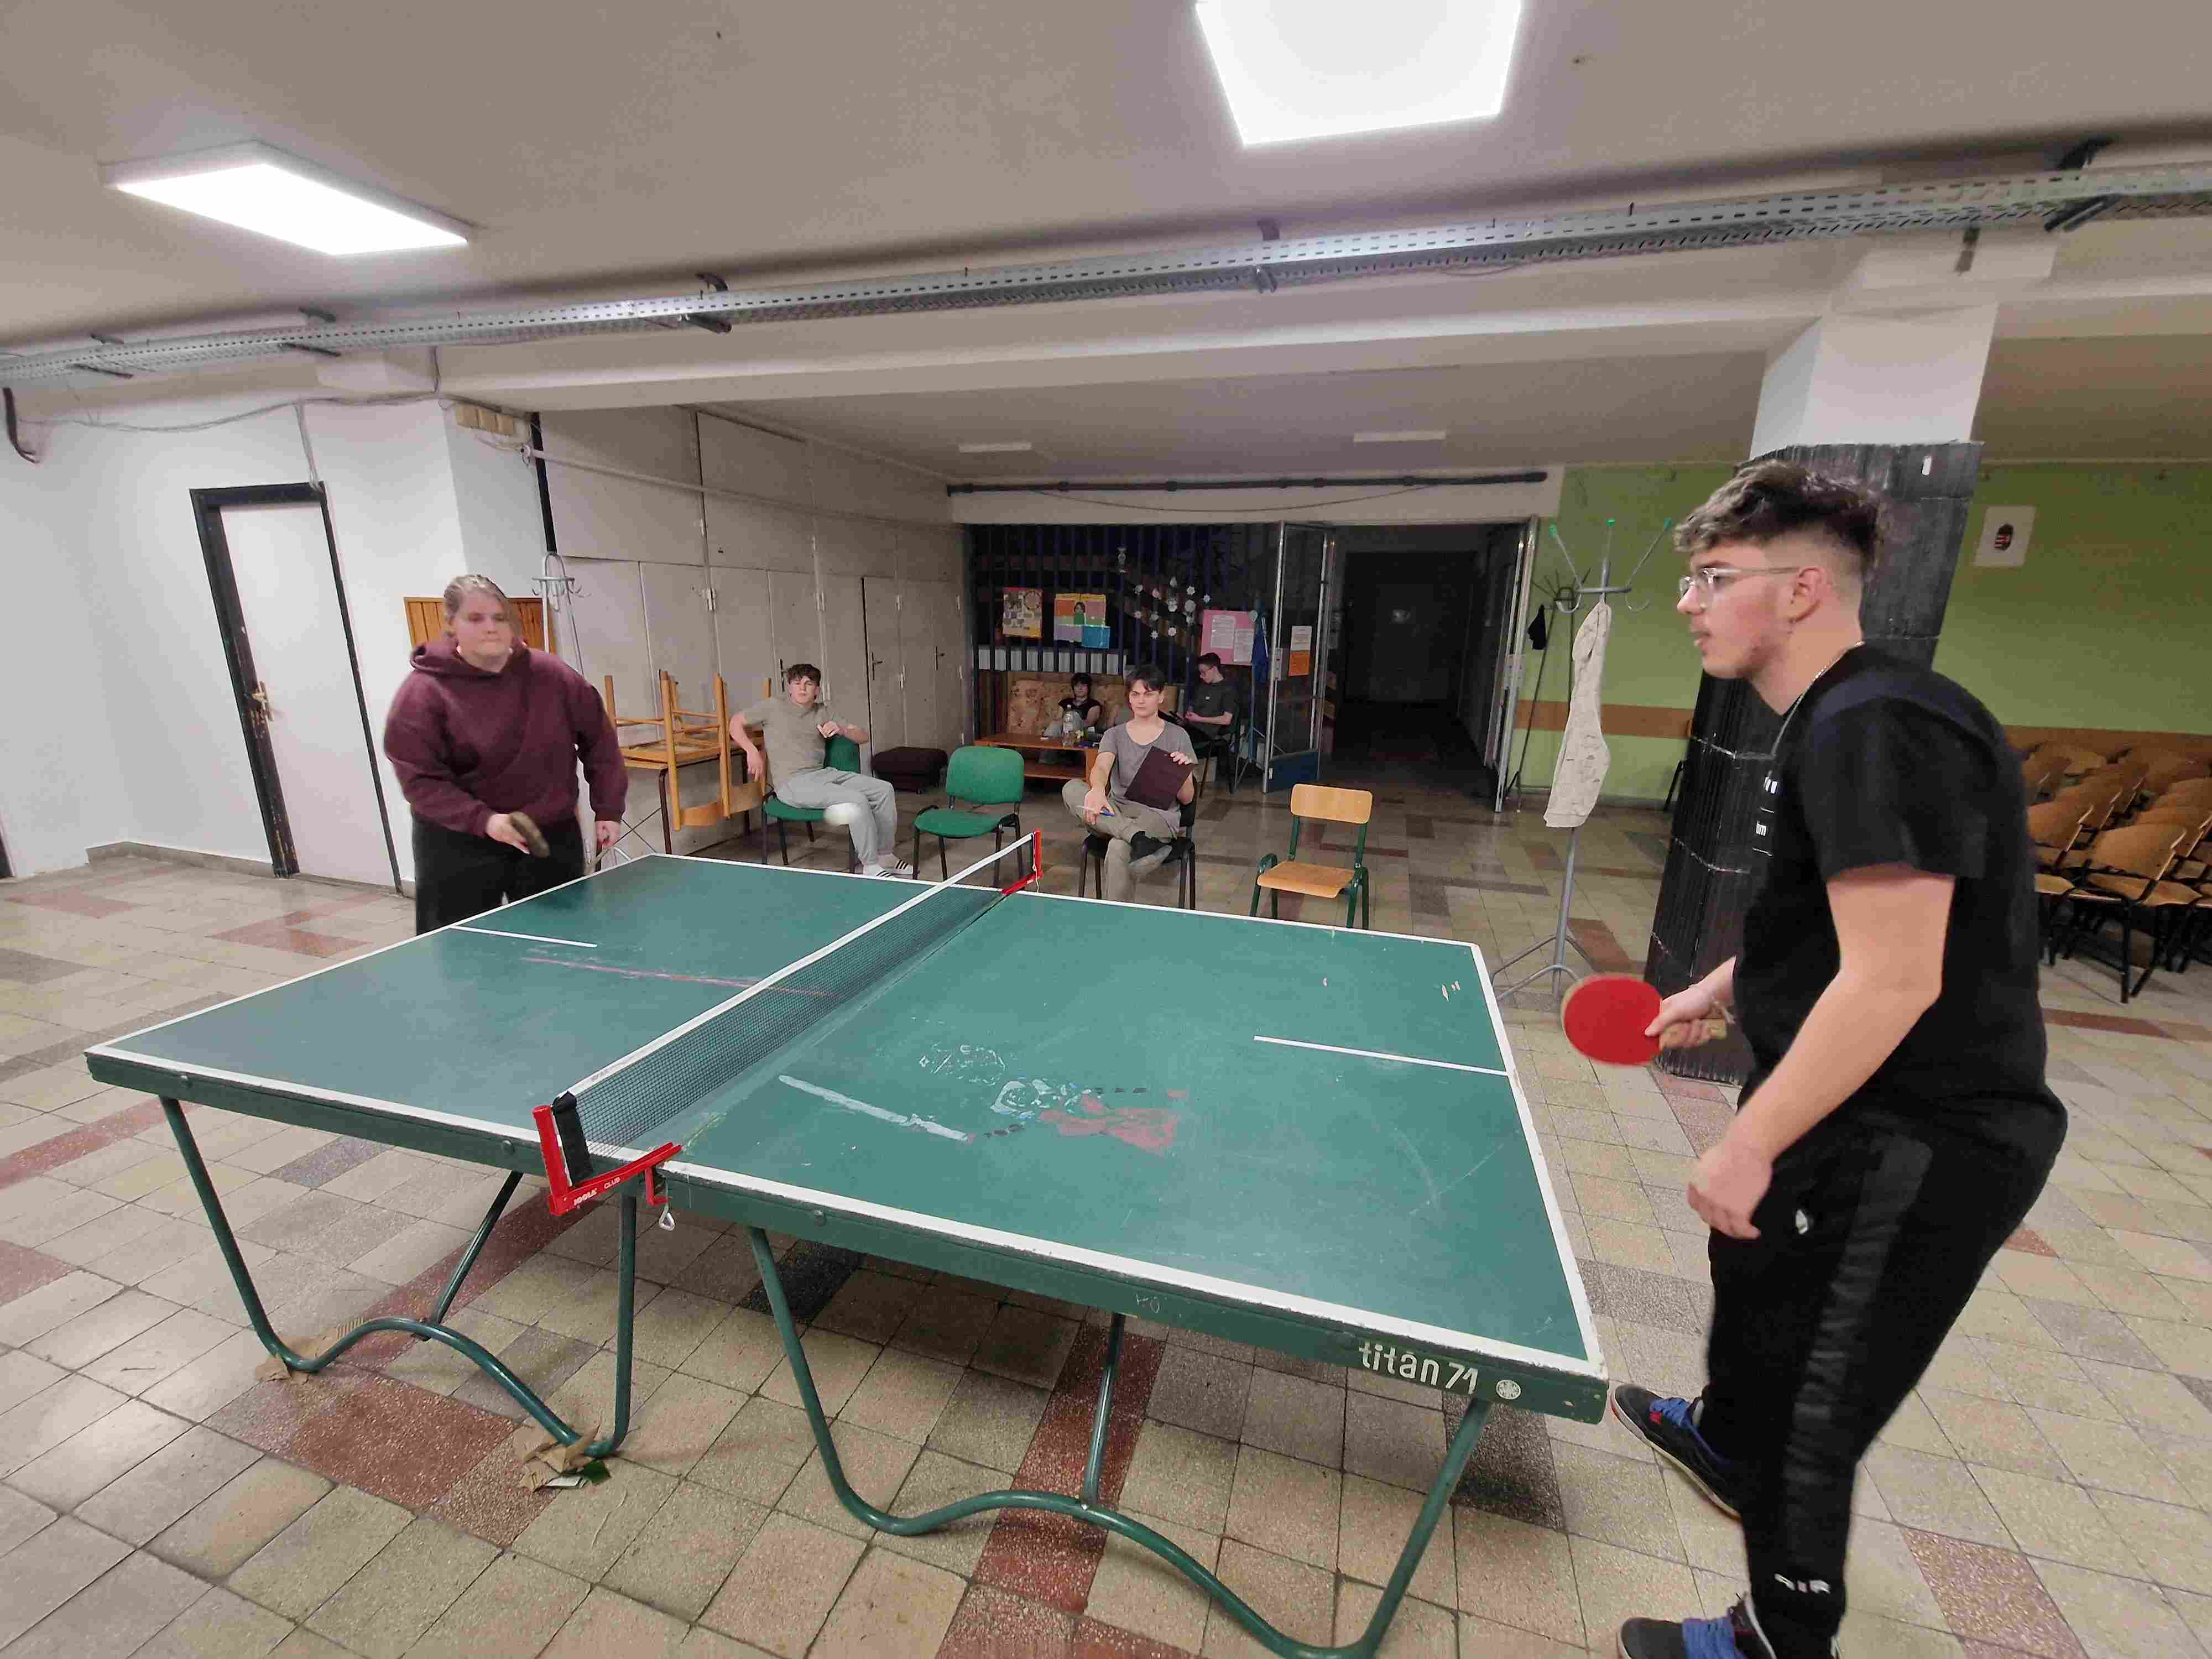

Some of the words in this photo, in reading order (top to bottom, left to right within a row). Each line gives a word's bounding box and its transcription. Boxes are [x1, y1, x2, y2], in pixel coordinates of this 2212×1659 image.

[604, 1177, 620, 1189] CLUB
[1358, 1341, 1439, 1385] titan
[1446, 1363, 1479, 1394] 71
